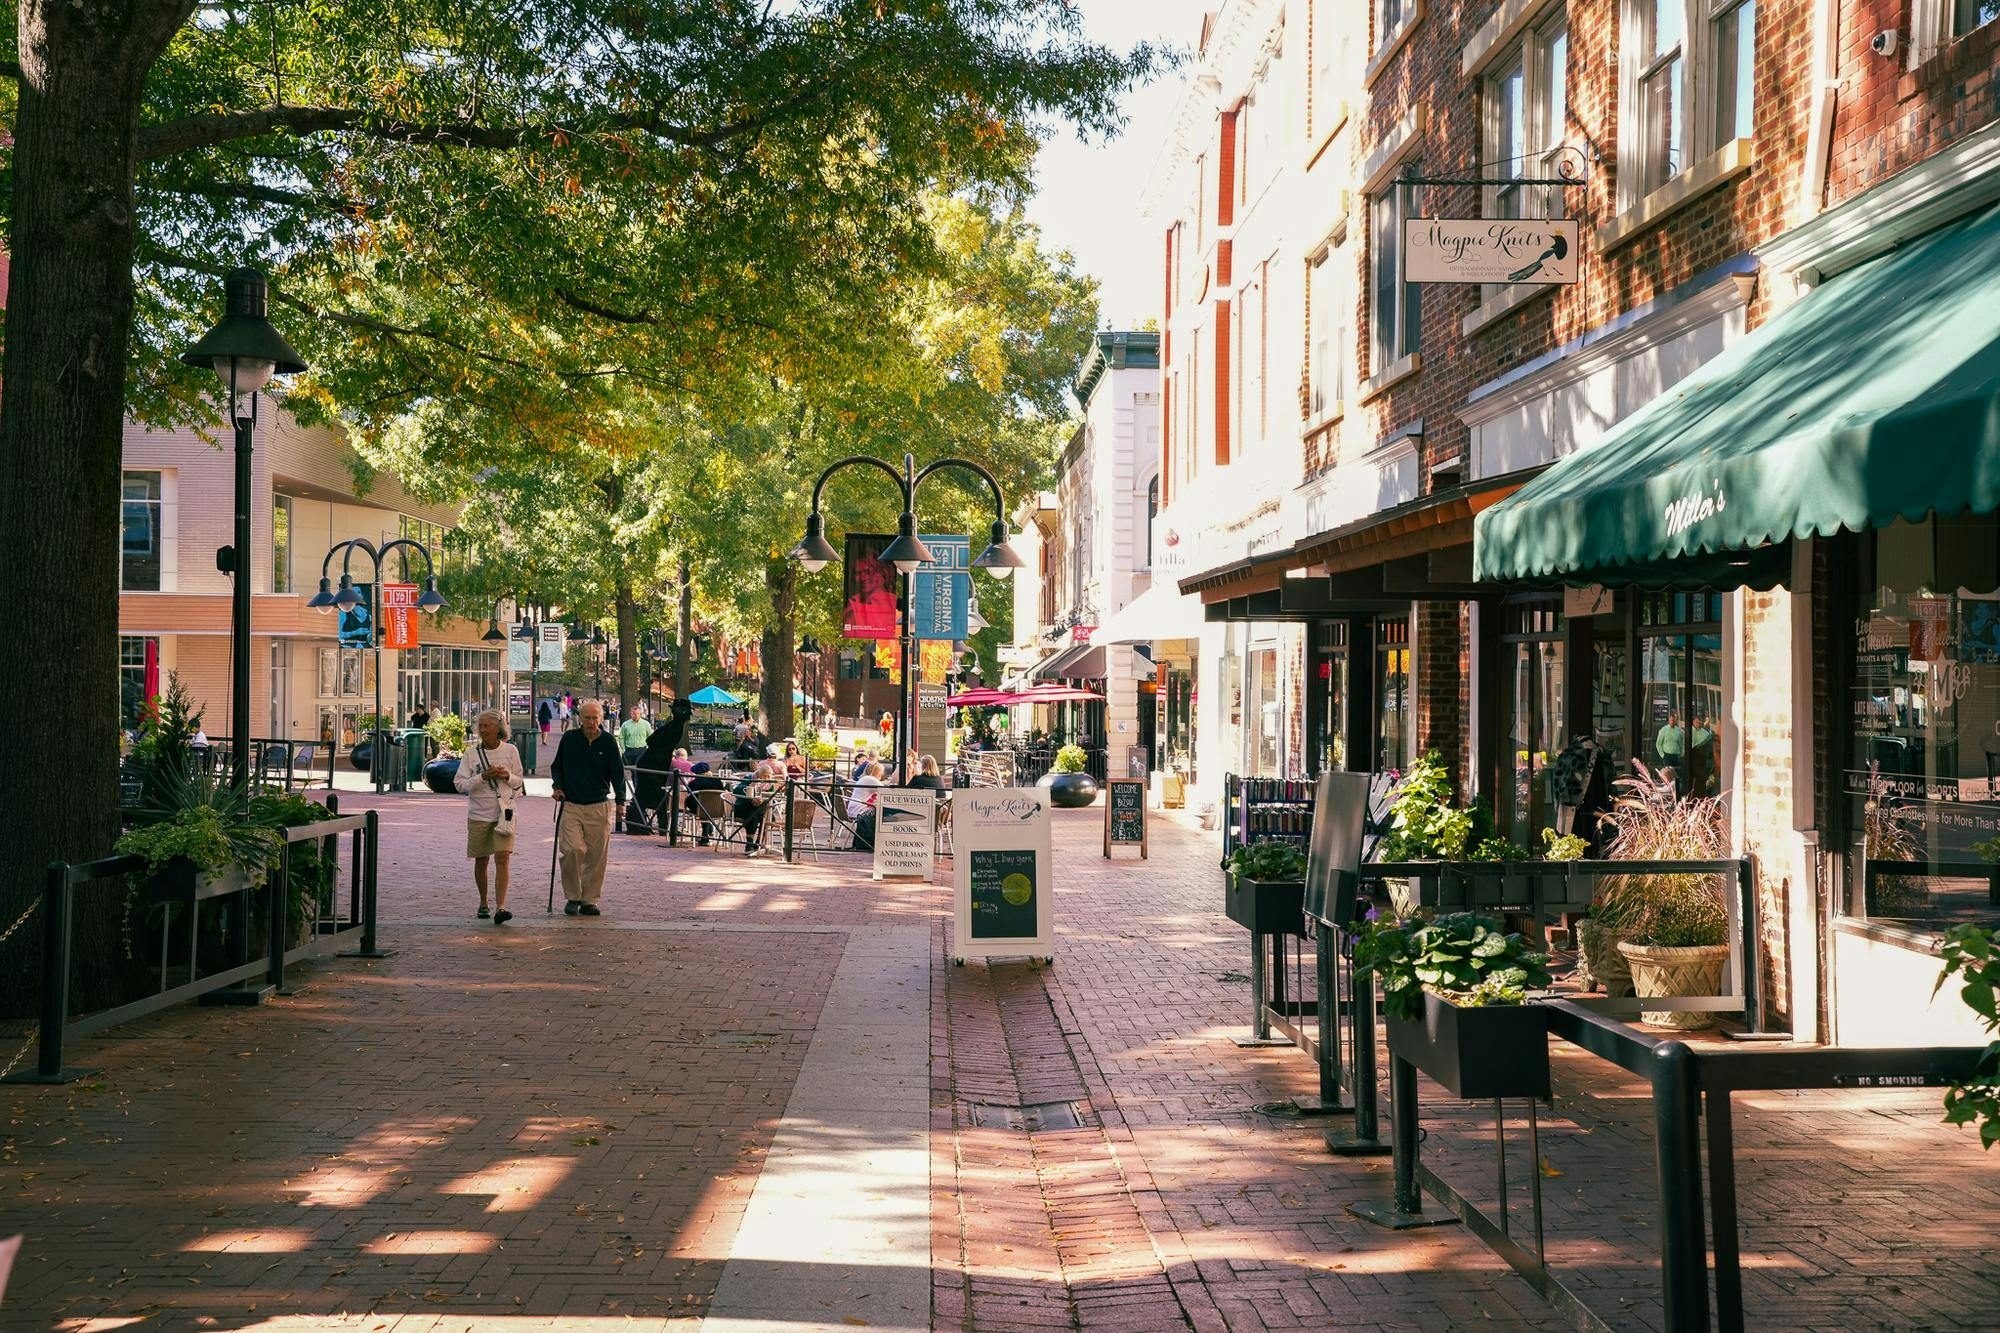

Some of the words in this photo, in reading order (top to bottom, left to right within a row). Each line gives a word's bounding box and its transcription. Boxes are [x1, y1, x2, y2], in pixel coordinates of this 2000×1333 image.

[1412, 225, 1488, 263] Magpie
[1488, 223, 1544, 259] Knits
[1665, 478, 1726, 537] Miller's
[942, 575, 953, 633] VIRGINIA
[1926, 784, 1958, 798] SPORTS
[966, 799, 1000, 817] Magpie
[1001, 798, 1030, 816] Knits
[1941, 812, 1952, 824] for
[1954, 814, 1974, 827] More
[1975, 816, 1995, 830] Than
[880, 850, 908, 858] ANTIQUE
[1001, 853, 1015, 866] buy
[1857, 1077, 1871, 1085] NO
[1878, 1076, 1925, 1085] SMOKING
